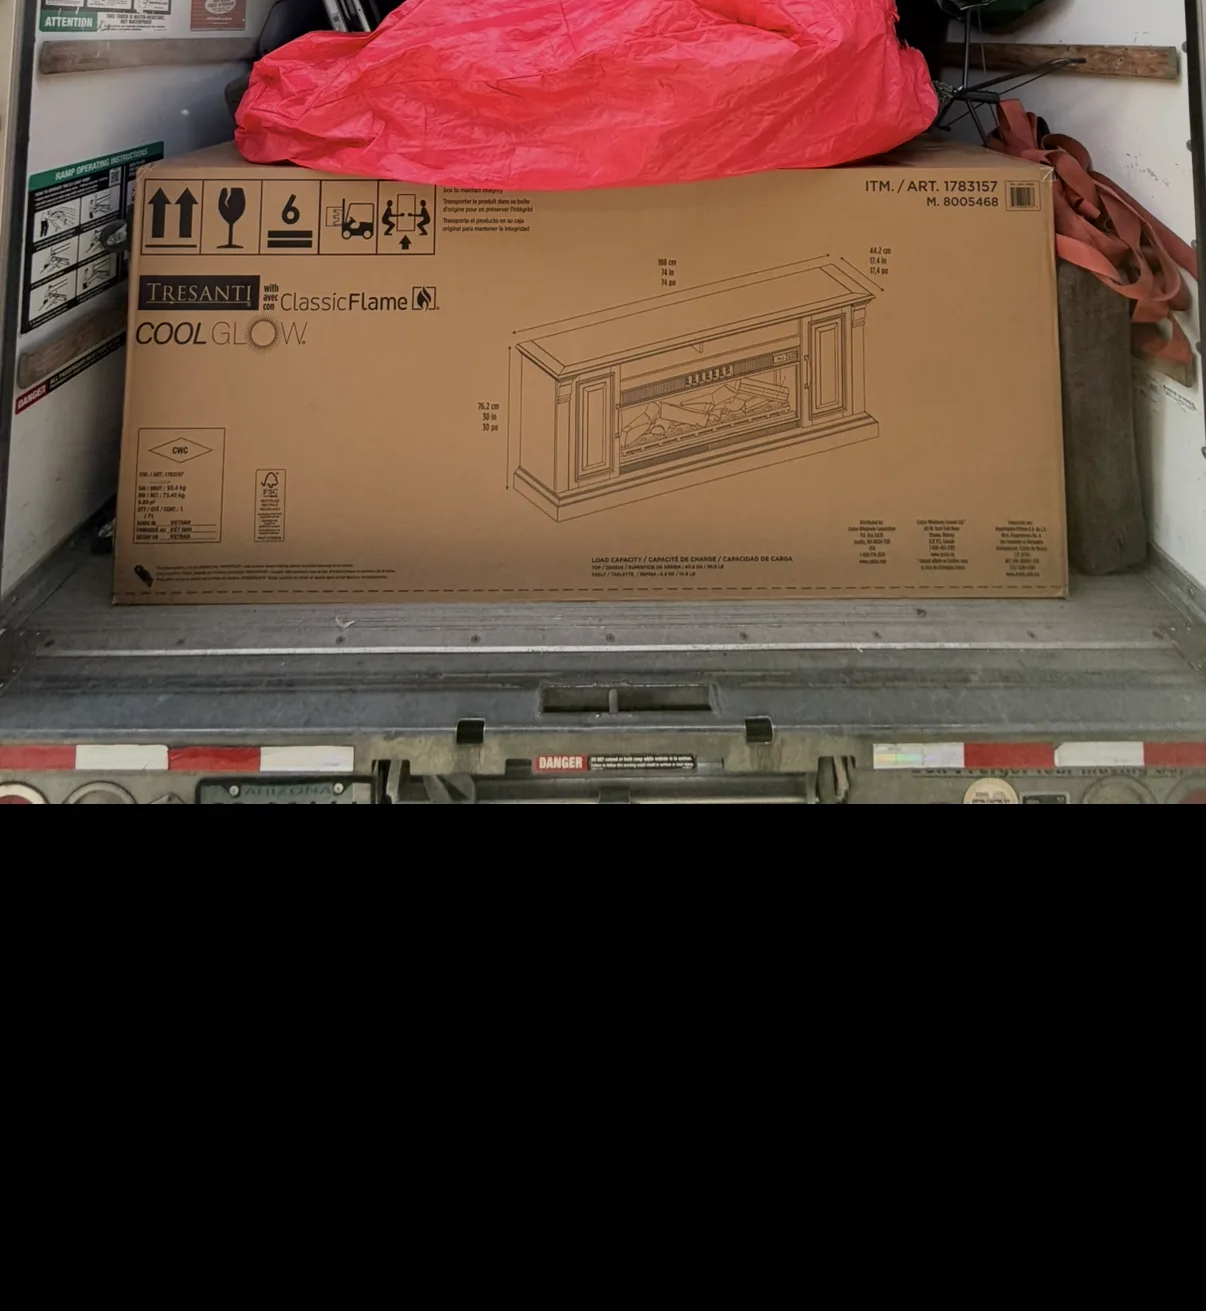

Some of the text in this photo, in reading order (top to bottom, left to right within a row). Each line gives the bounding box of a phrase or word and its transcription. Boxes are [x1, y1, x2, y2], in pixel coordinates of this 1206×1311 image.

[44, 16, 93, 27] ATTENTION
[55, 148, 148, 181] RAMP OPERATING INSTRUCTIONS
[865, 180, 894, 192] ITM.
[907, 180, 939, 192] ART.
[944, 180, 998, 192] 1783157
[926, 197, 999, 207] M. 8005468
[281, 193, 300, 225] 6
[661, 268, 674, 276] 74 in
[661, 278, 667, 286] 74
[146, 282, 252, 302] TRESANTI
[263, 284, 279, 293] with
[263, 294, 278, 302] avec
[280, 292, 407, 311] ClassicFlame
[263, 303, 275, 311] con
[136, 321, 207, 345] COOL
[18, 385, 46, 409] DANGER
[478, 402, 490, 410] 76.2
[483, 413, 490, 421] 30
[483, 423, 499, 432] 30 po
[172, 446, 189, 455] CWC
[539, 756, 583, 769] DANGER
[245, 785, 332, 796] ARIZONA
